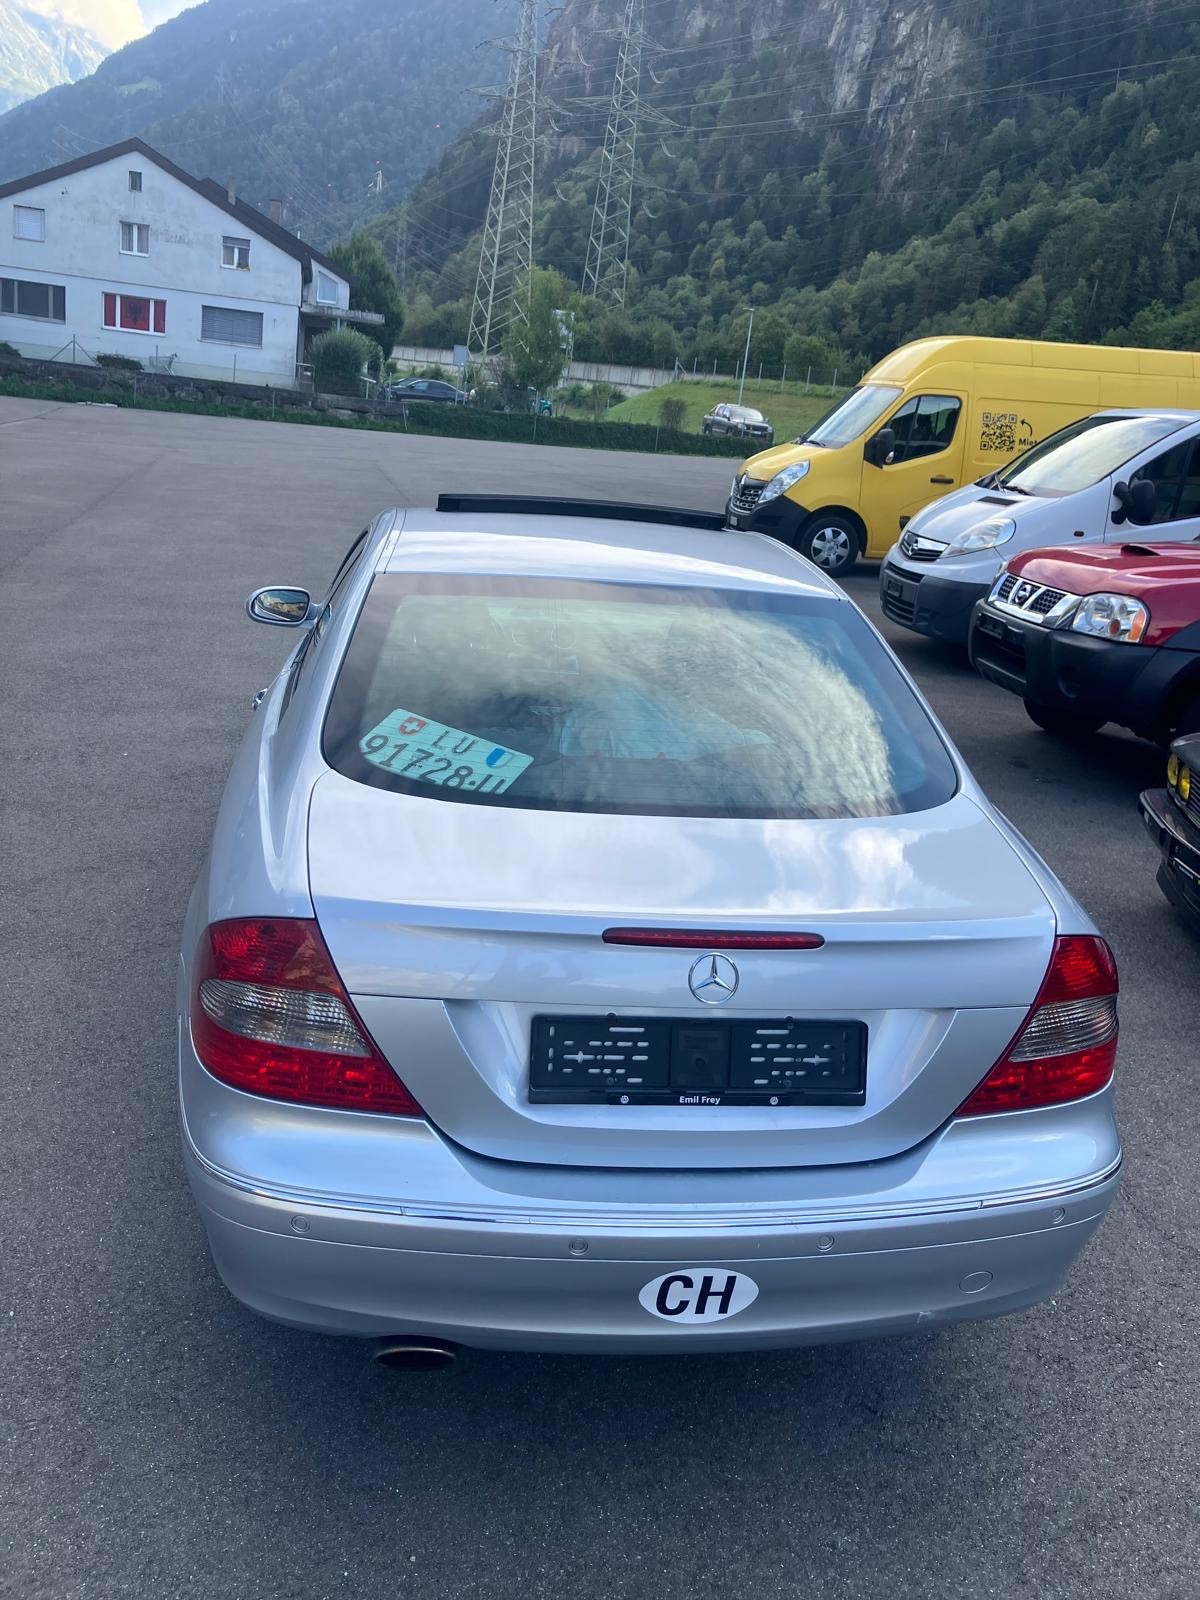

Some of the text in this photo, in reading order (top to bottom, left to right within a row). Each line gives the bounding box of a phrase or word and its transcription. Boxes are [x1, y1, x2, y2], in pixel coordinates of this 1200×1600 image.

[432, 730, 480, 754] LU
[680, 1095, 721, 1106] Emil Frey
[656, 1275, 737, 1316] CH
